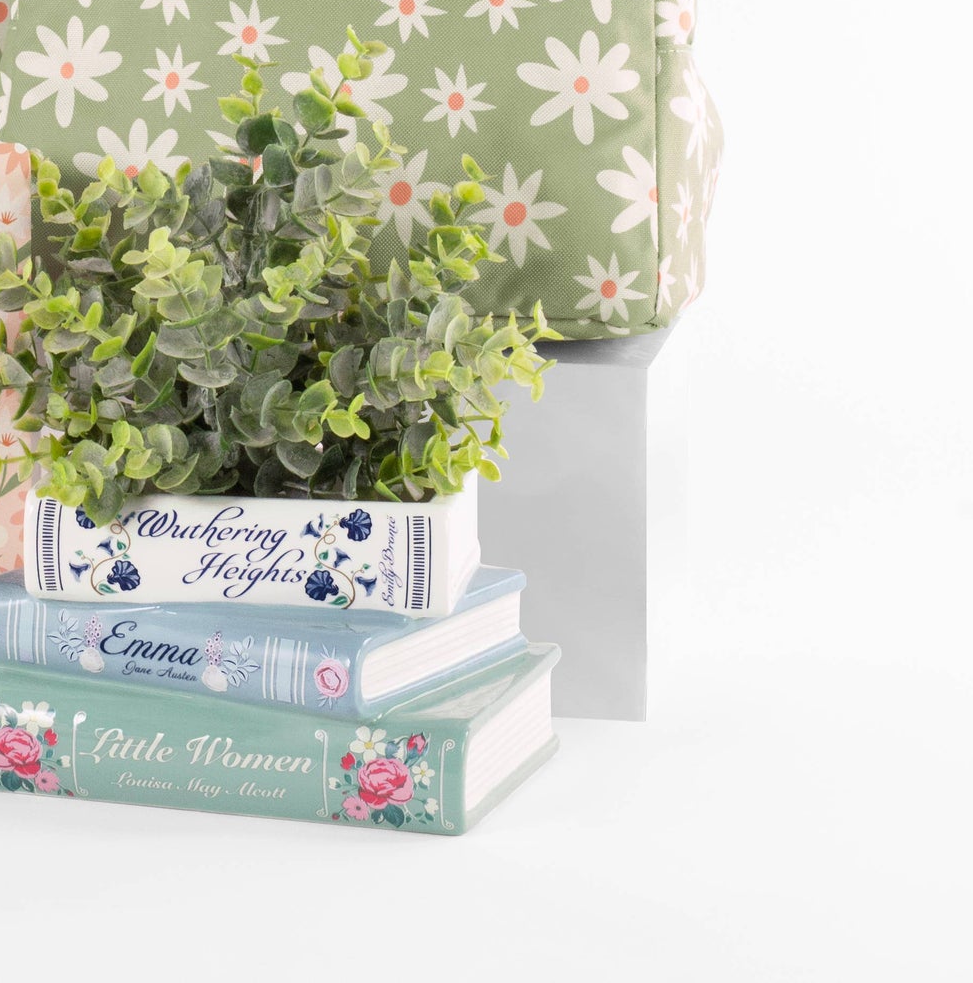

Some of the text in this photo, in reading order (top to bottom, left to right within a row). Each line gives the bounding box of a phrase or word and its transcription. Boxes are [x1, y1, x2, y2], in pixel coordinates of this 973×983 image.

[137, 506, 288, 563] Wuthering
[182, 548, 307, 599] Heights
[379, 514, 403, 607] Emily Brontë
[99, 620, 203, 666] Emma
[122, 660, 198, 682] Jane Austen
[79, 727, 318, 774] Little Women
[111, 771, 288, 800] Louisa May Alcott
